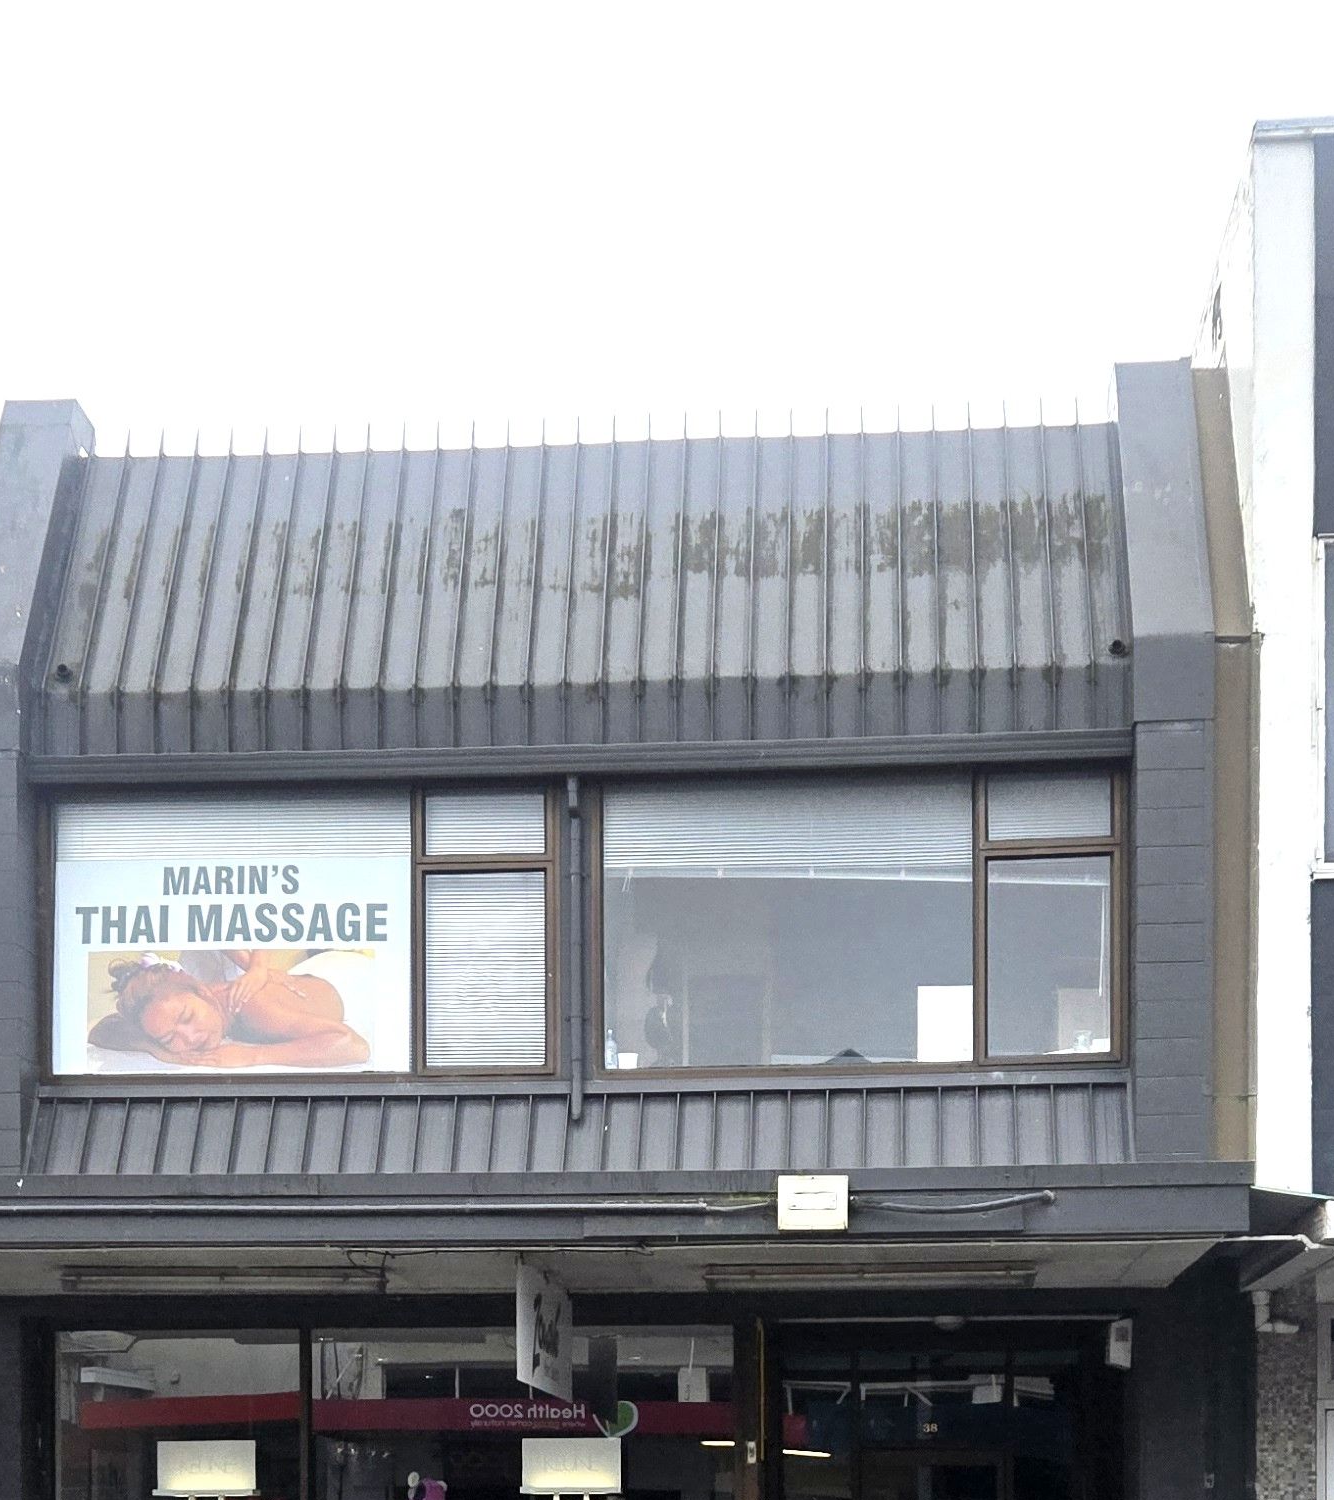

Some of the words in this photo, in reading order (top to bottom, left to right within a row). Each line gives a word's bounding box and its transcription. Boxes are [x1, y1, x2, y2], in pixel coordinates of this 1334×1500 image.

[162, 865, 300, 896] MARIN'S
[75, 905, 169, 945] THAI
[187, 902, 388, 943] MASSAGE
[922, 1423, 939, 1433] 38
